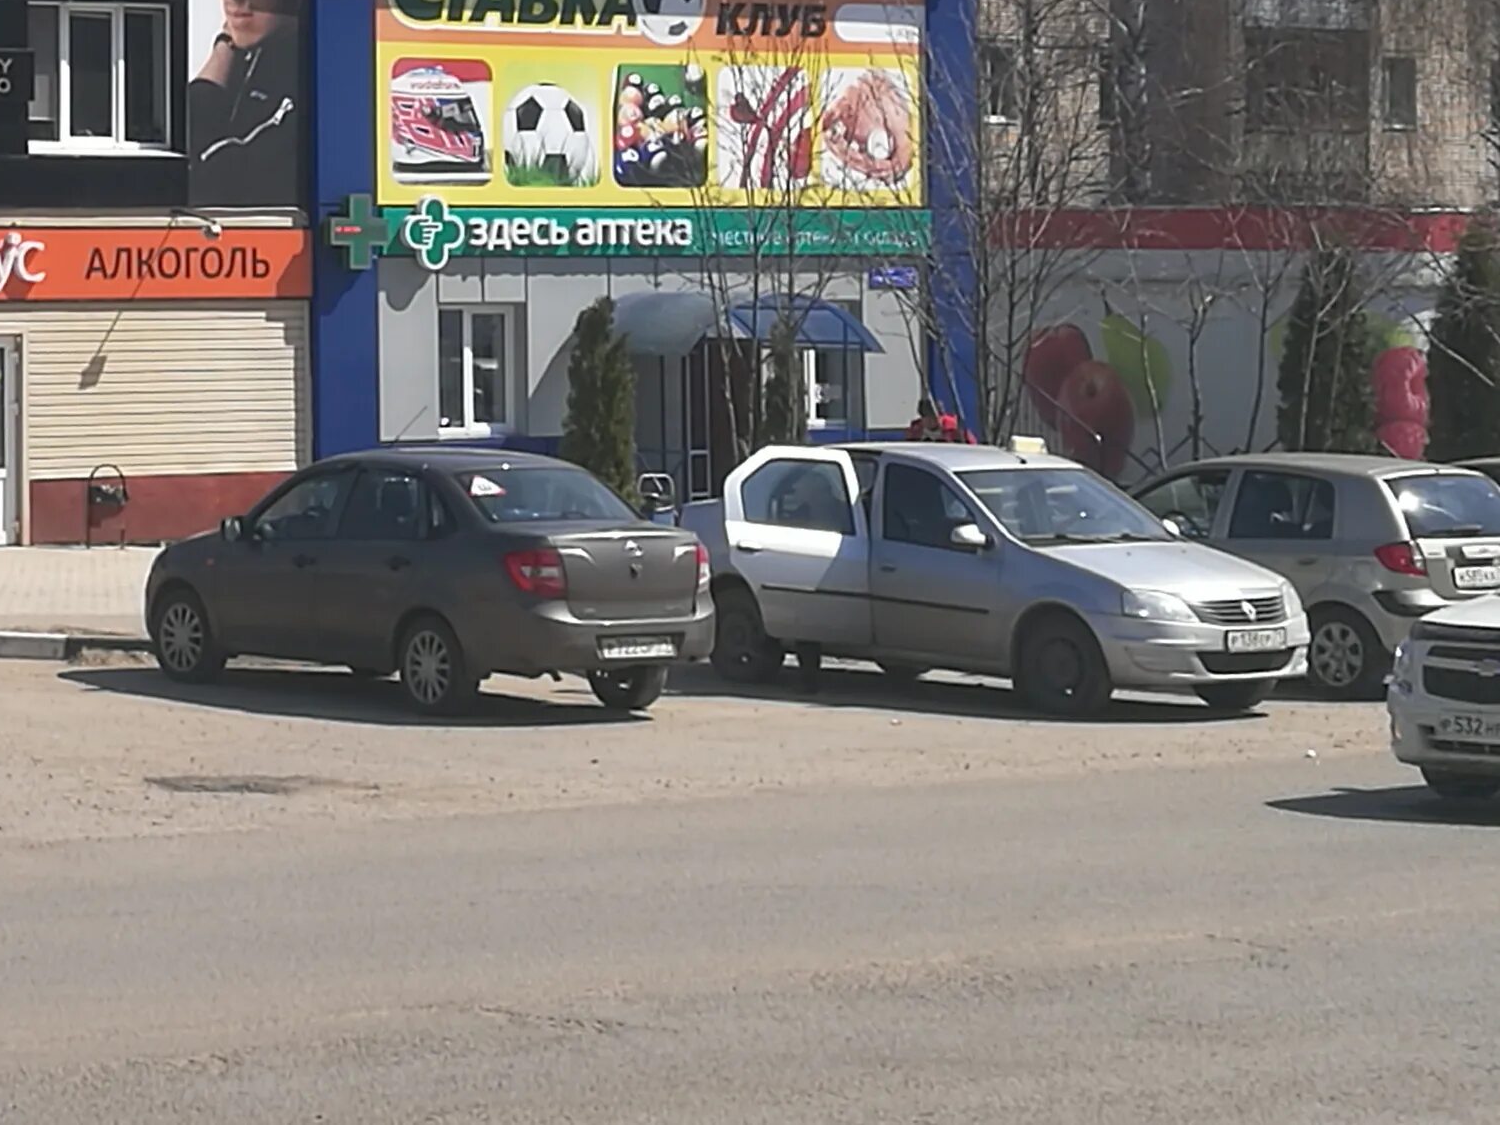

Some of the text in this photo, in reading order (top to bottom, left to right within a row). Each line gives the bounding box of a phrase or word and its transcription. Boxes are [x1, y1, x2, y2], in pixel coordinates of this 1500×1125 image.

[715, 2, 828, 37] КЛУБ
[468, 217, 691, 251] здесь аптека
[85, 245, 272, 282] АЛКОГОЛЬ
